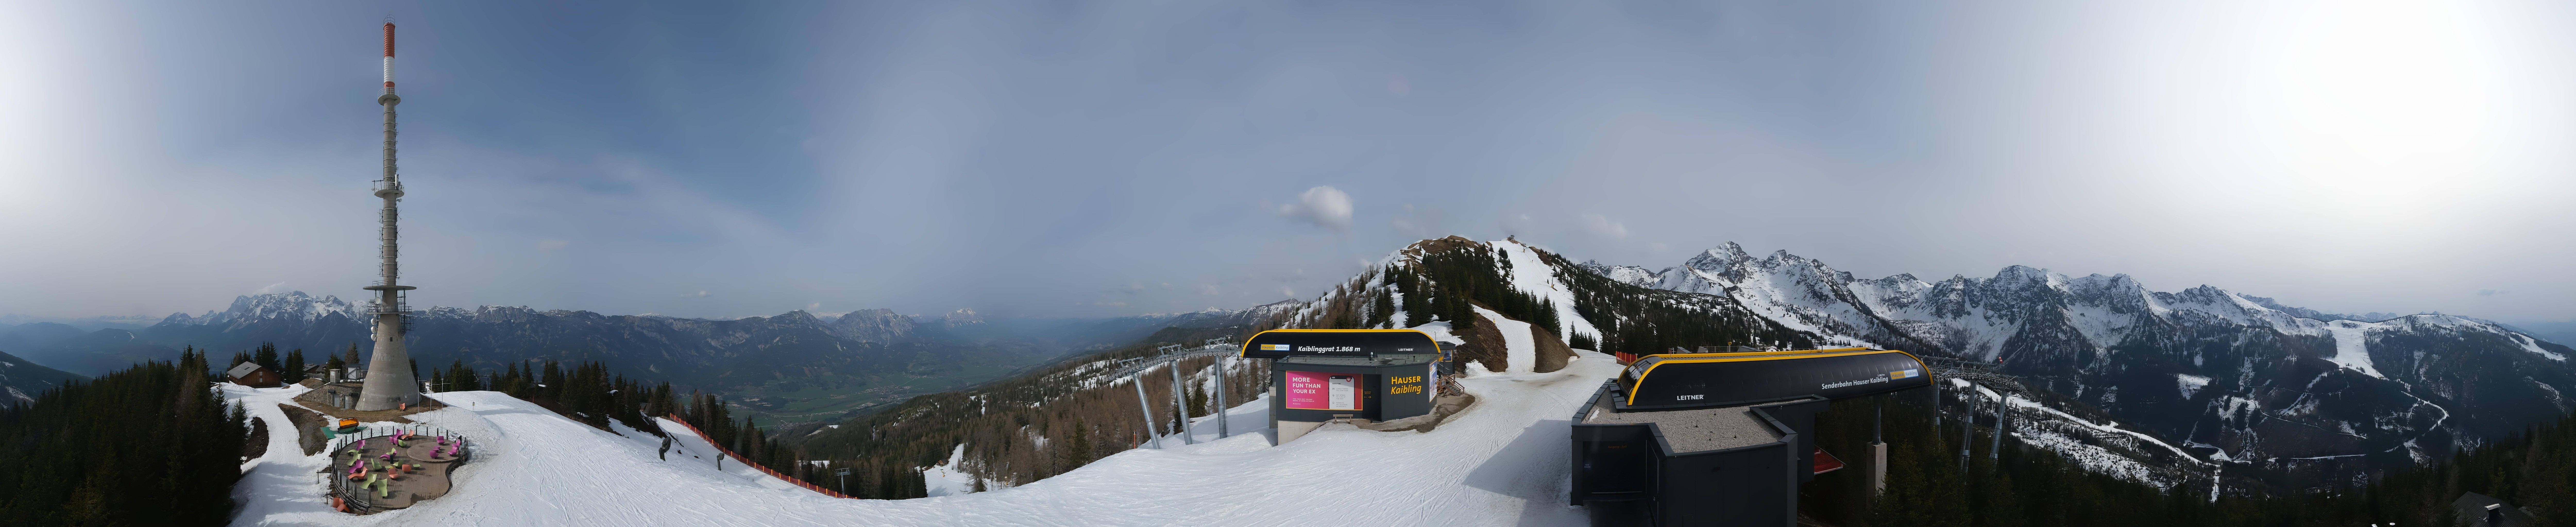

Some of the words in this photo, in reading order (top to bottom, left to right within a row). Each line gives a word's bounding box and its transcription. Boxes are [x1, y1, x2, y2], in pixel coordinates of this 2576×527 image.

[1391, 376, 1421, 385] HAUSER
[1822, 381, 1852, 389] Senderbahn
[1391, 385, 1421, 395] Kaibling
